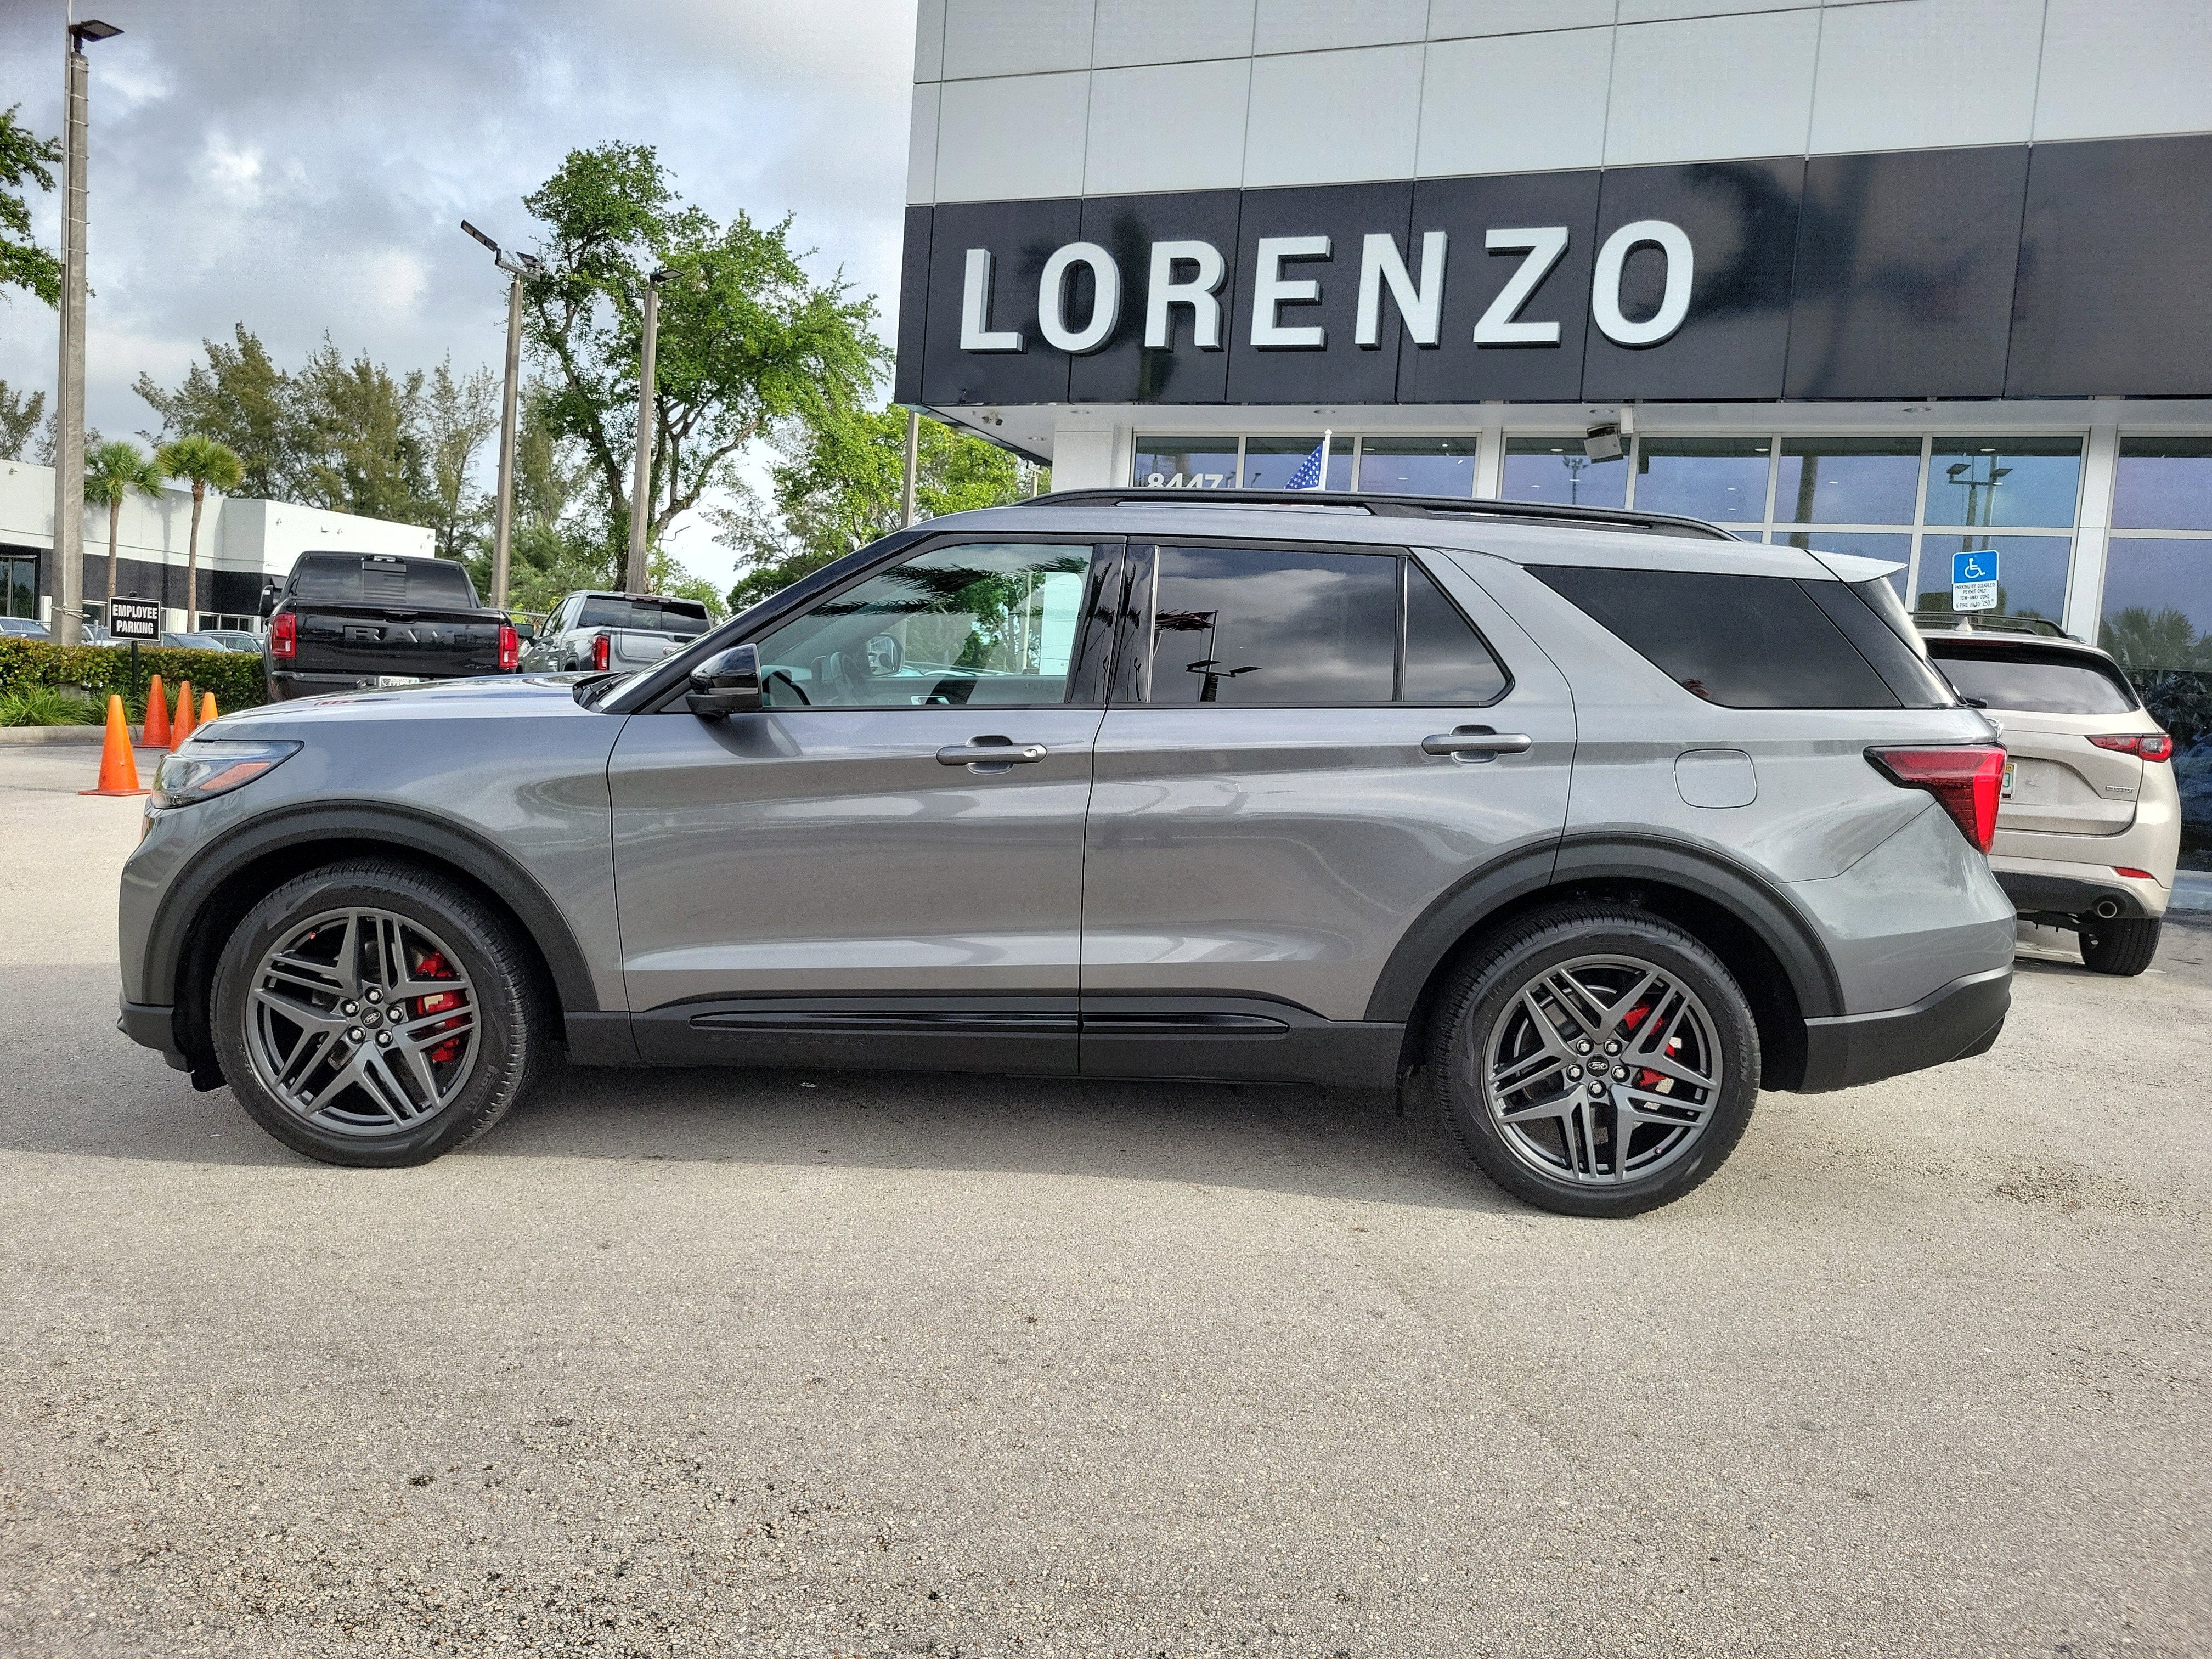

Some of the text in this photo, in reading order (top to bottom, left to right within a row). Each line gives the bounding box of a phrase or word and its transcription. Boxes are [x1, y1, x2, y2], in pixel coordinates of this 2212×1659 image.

[958, 220, 1695, 354] LORENZO
[1147, 473, 1223, 488] 8447
[112, 604, 157, 619] EMPLOYEE
[116, 620, 154, 634] PARKING
[343, 625, 455, 645] RAM
